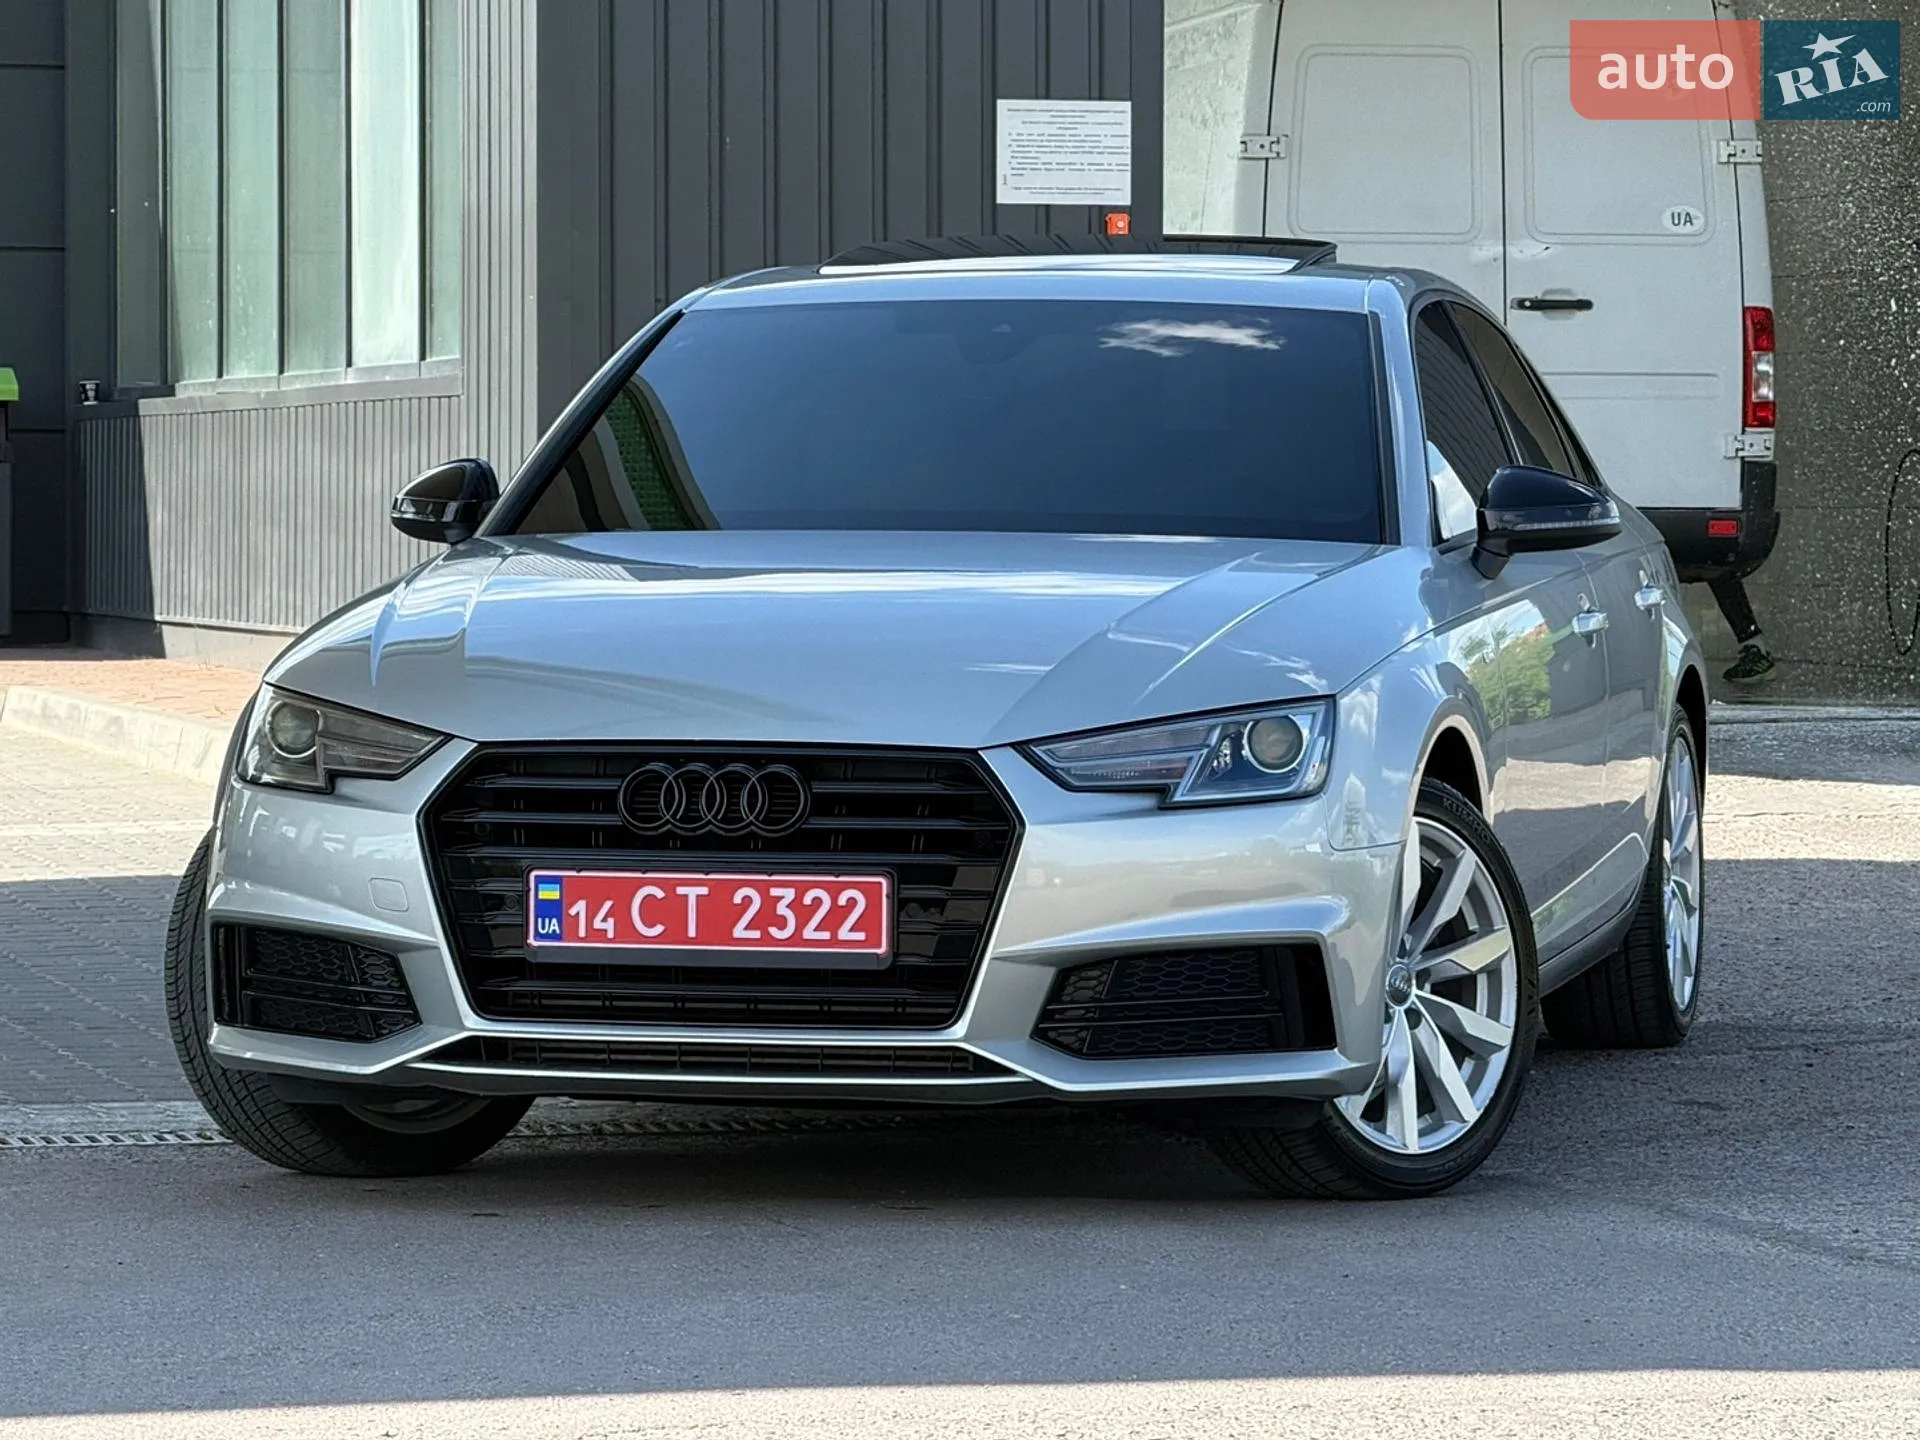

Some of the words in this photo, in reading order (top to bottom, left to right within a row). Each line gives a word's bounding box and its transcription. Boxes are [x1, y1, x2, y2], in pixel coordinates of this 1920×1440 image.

[1671, 211, 1694, 227] UA
[567, 899, 615, 939] 14
[630, 885, 710, 939] CT
[732, 886, 867, 941] 2322
[537, 917, 561, 935] UA
